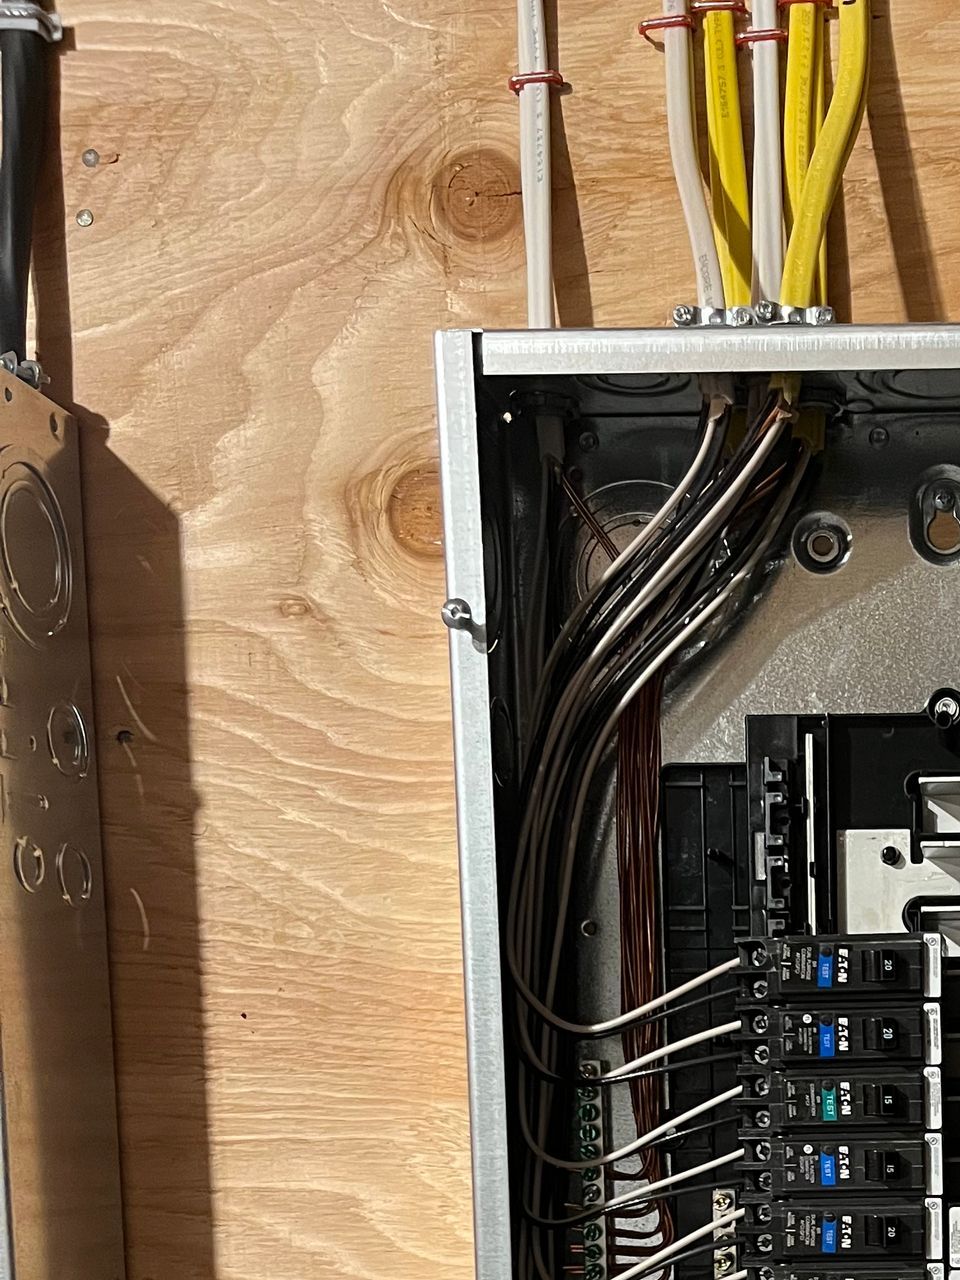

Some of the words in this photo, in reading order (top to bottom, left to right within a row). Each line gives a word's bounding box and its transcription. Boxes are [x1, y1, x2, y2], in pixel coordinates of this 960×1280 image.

[884, 959, 892, 971] 20
[883, 1028, 893, 1040] 20
[826, 1095, 834, 1115] TEST
[884, 1095, 892, 1104] 15
[886, 1164, 895, 1173] 15
[887, 1227, 896, 1238] 20
